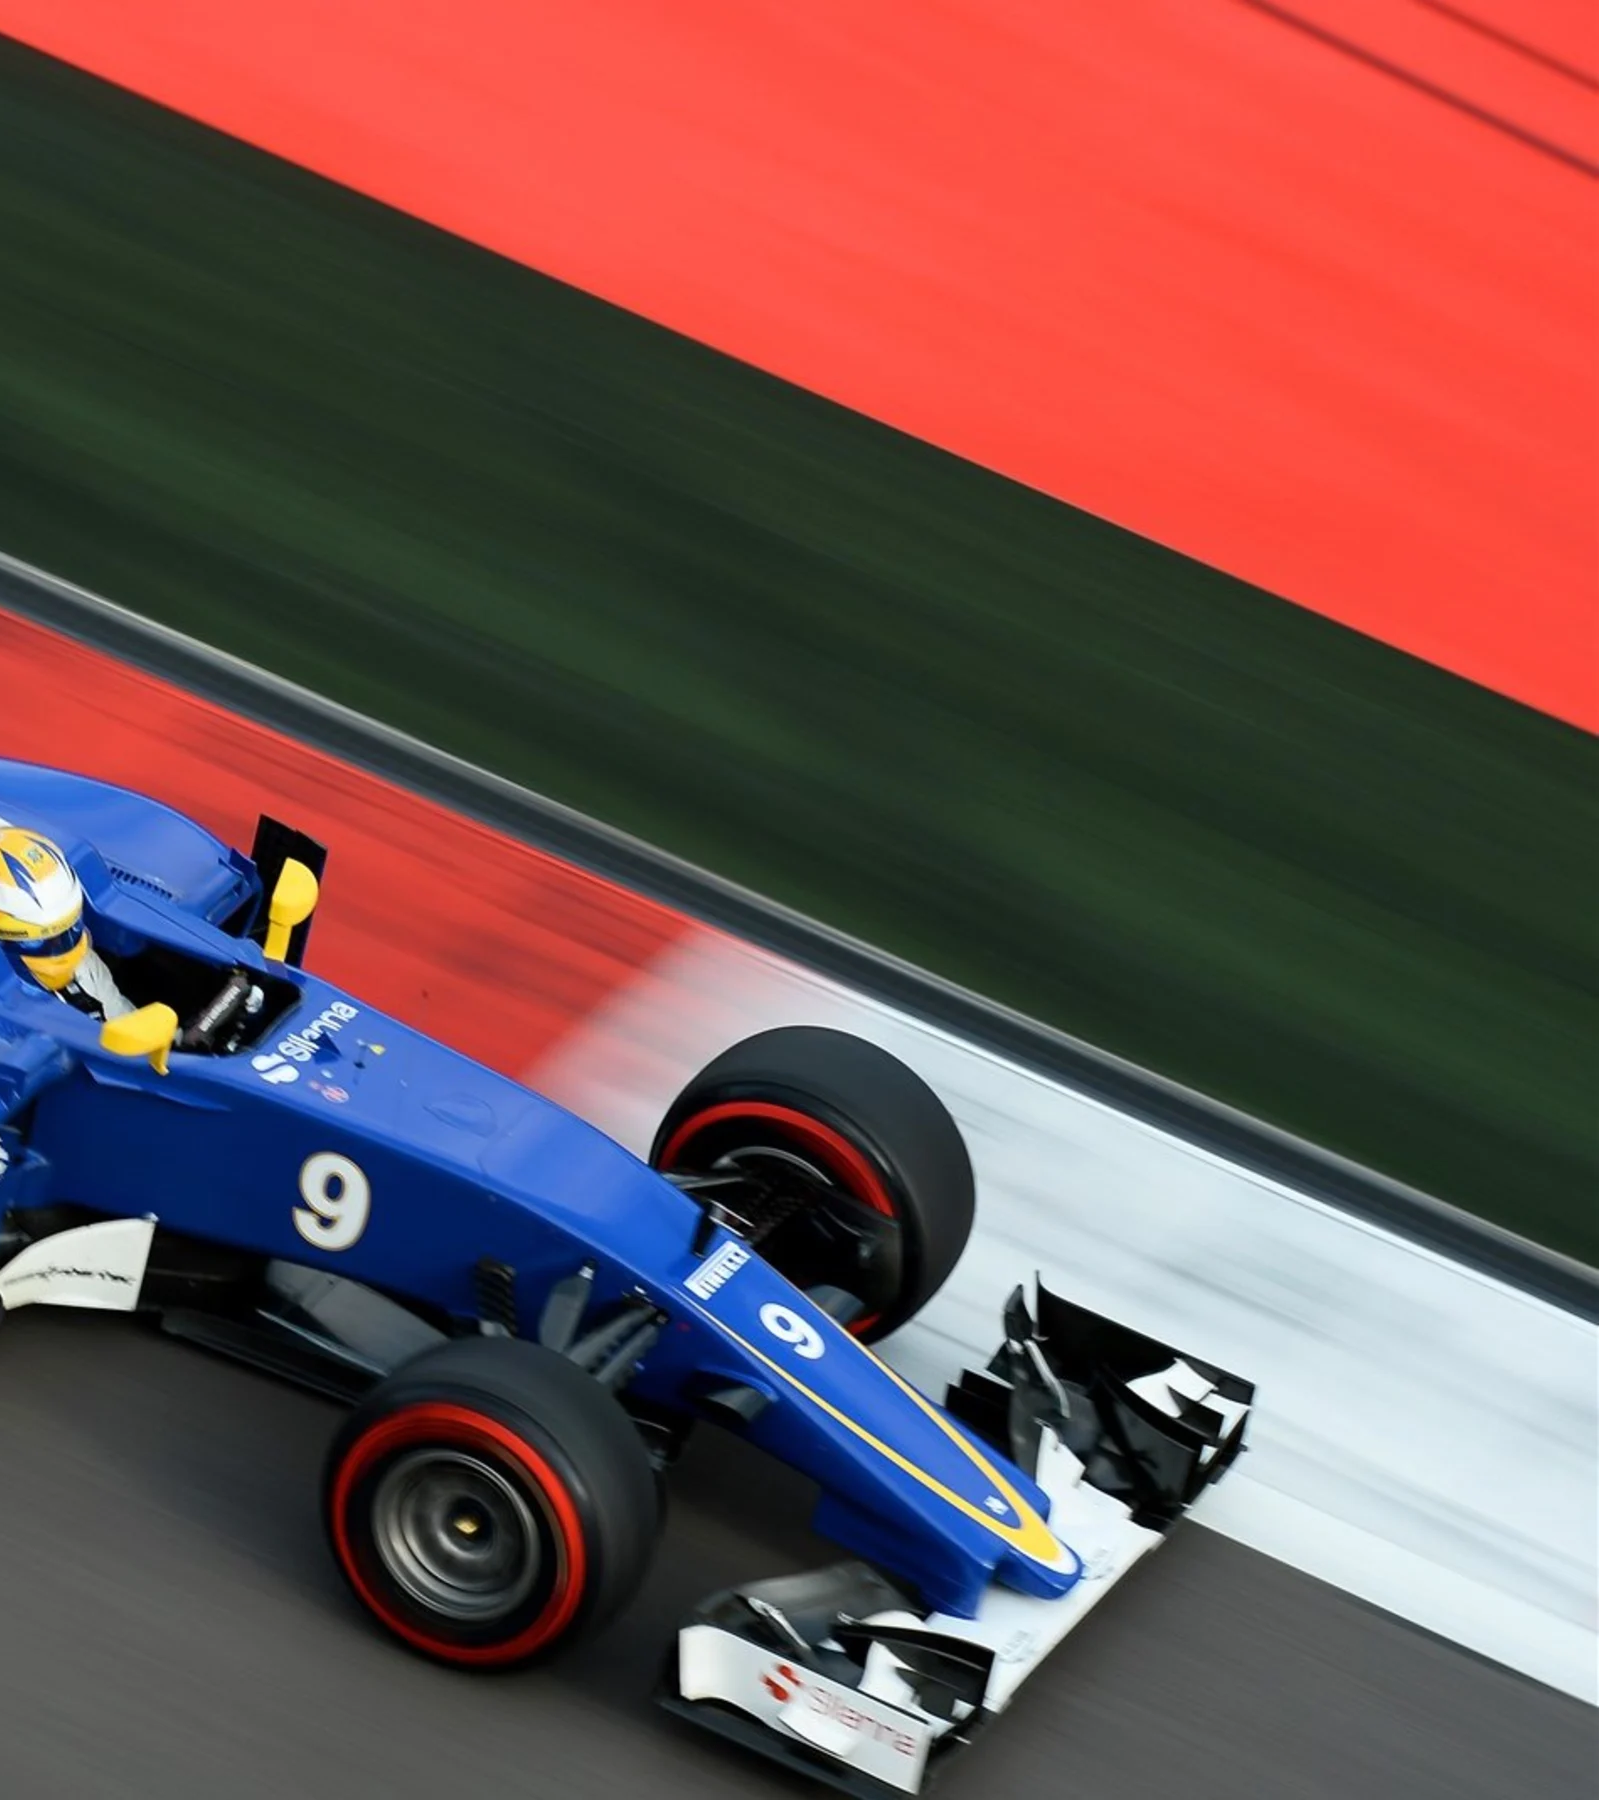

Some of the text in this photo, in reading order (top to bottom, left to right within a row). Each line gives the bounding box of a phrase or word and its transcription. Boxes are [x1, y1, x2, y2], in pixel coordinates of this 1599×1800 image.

[278, 1001, 359, 1062] Silanna
[291, 1151, 371, 1251] 9
[683, 1240, 751, 1301] PIRELLI
[759, 1303, 825, 1360] 9
